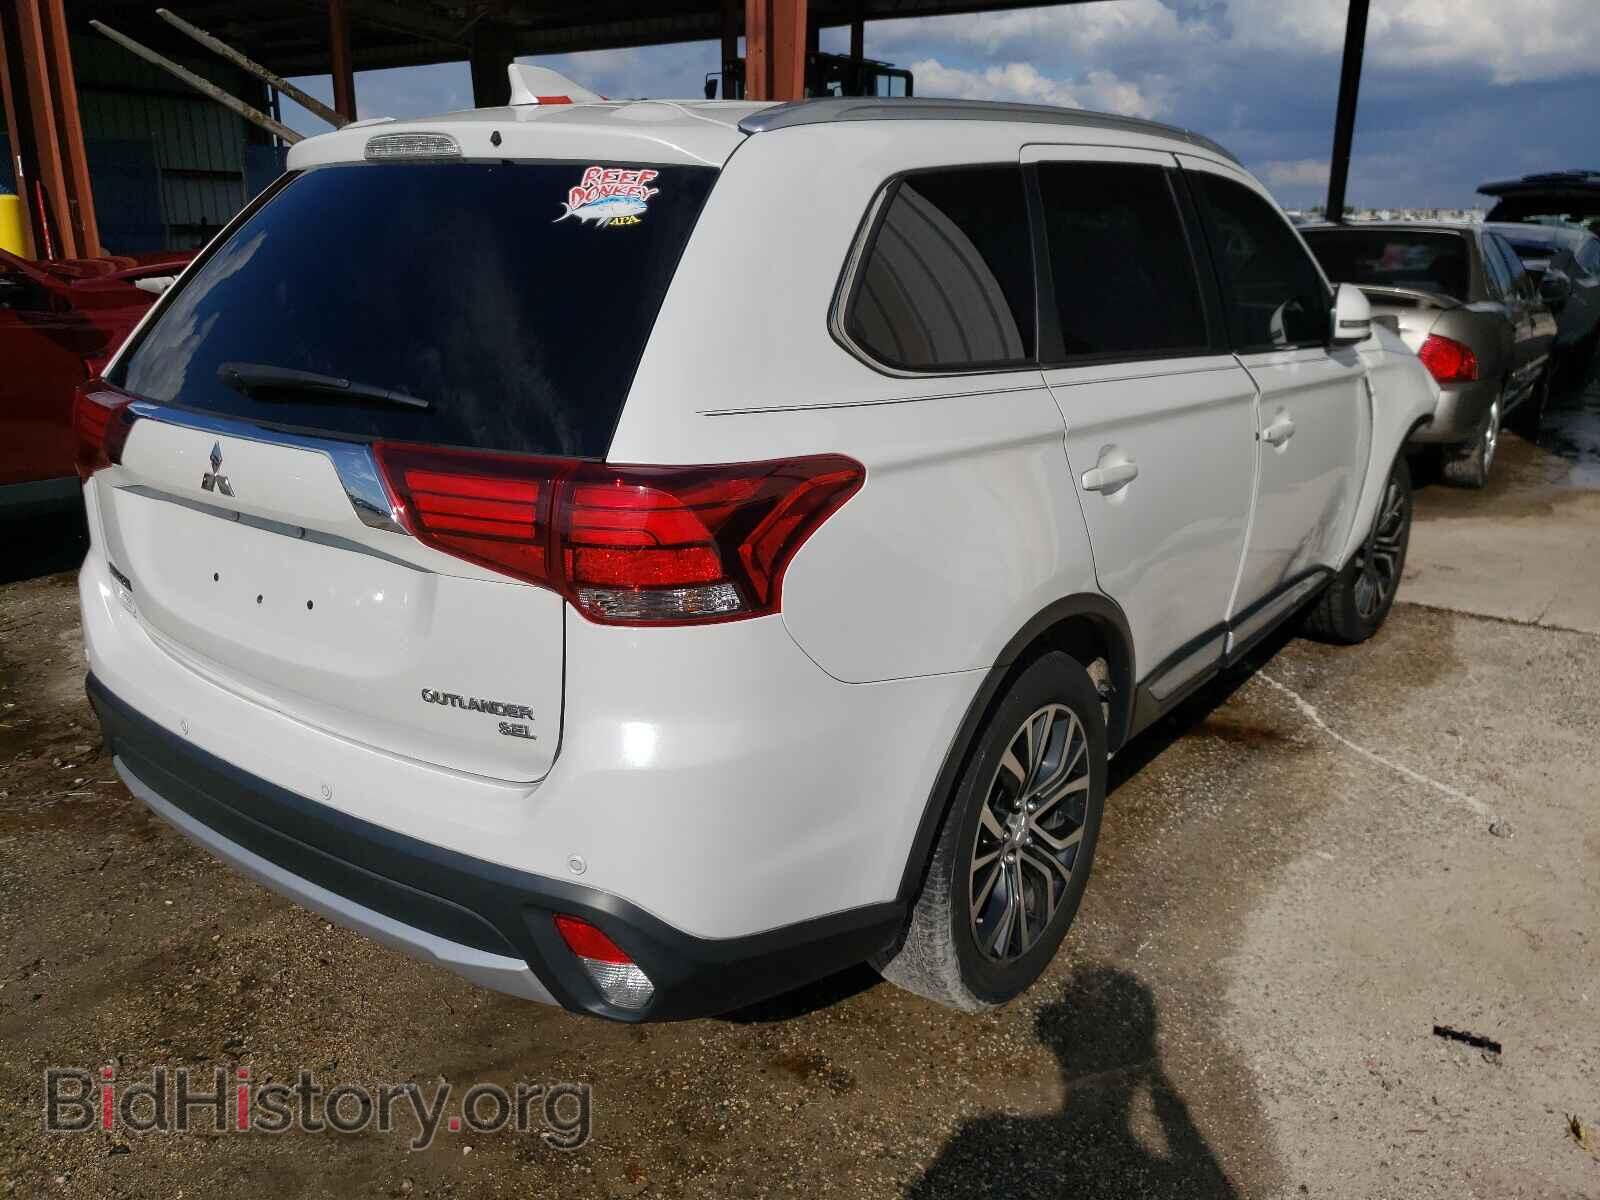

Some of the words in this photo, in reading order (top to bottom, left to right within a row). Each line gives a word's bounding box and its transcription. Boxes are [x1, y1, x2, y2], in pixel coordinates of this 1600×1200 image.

[581, 166, 659, 188] REEF
[568, 184, 659, 210] DONKEY
[421, 688, 535, 720] OUTLANDER
[498, 721, 537, 740] SEL
